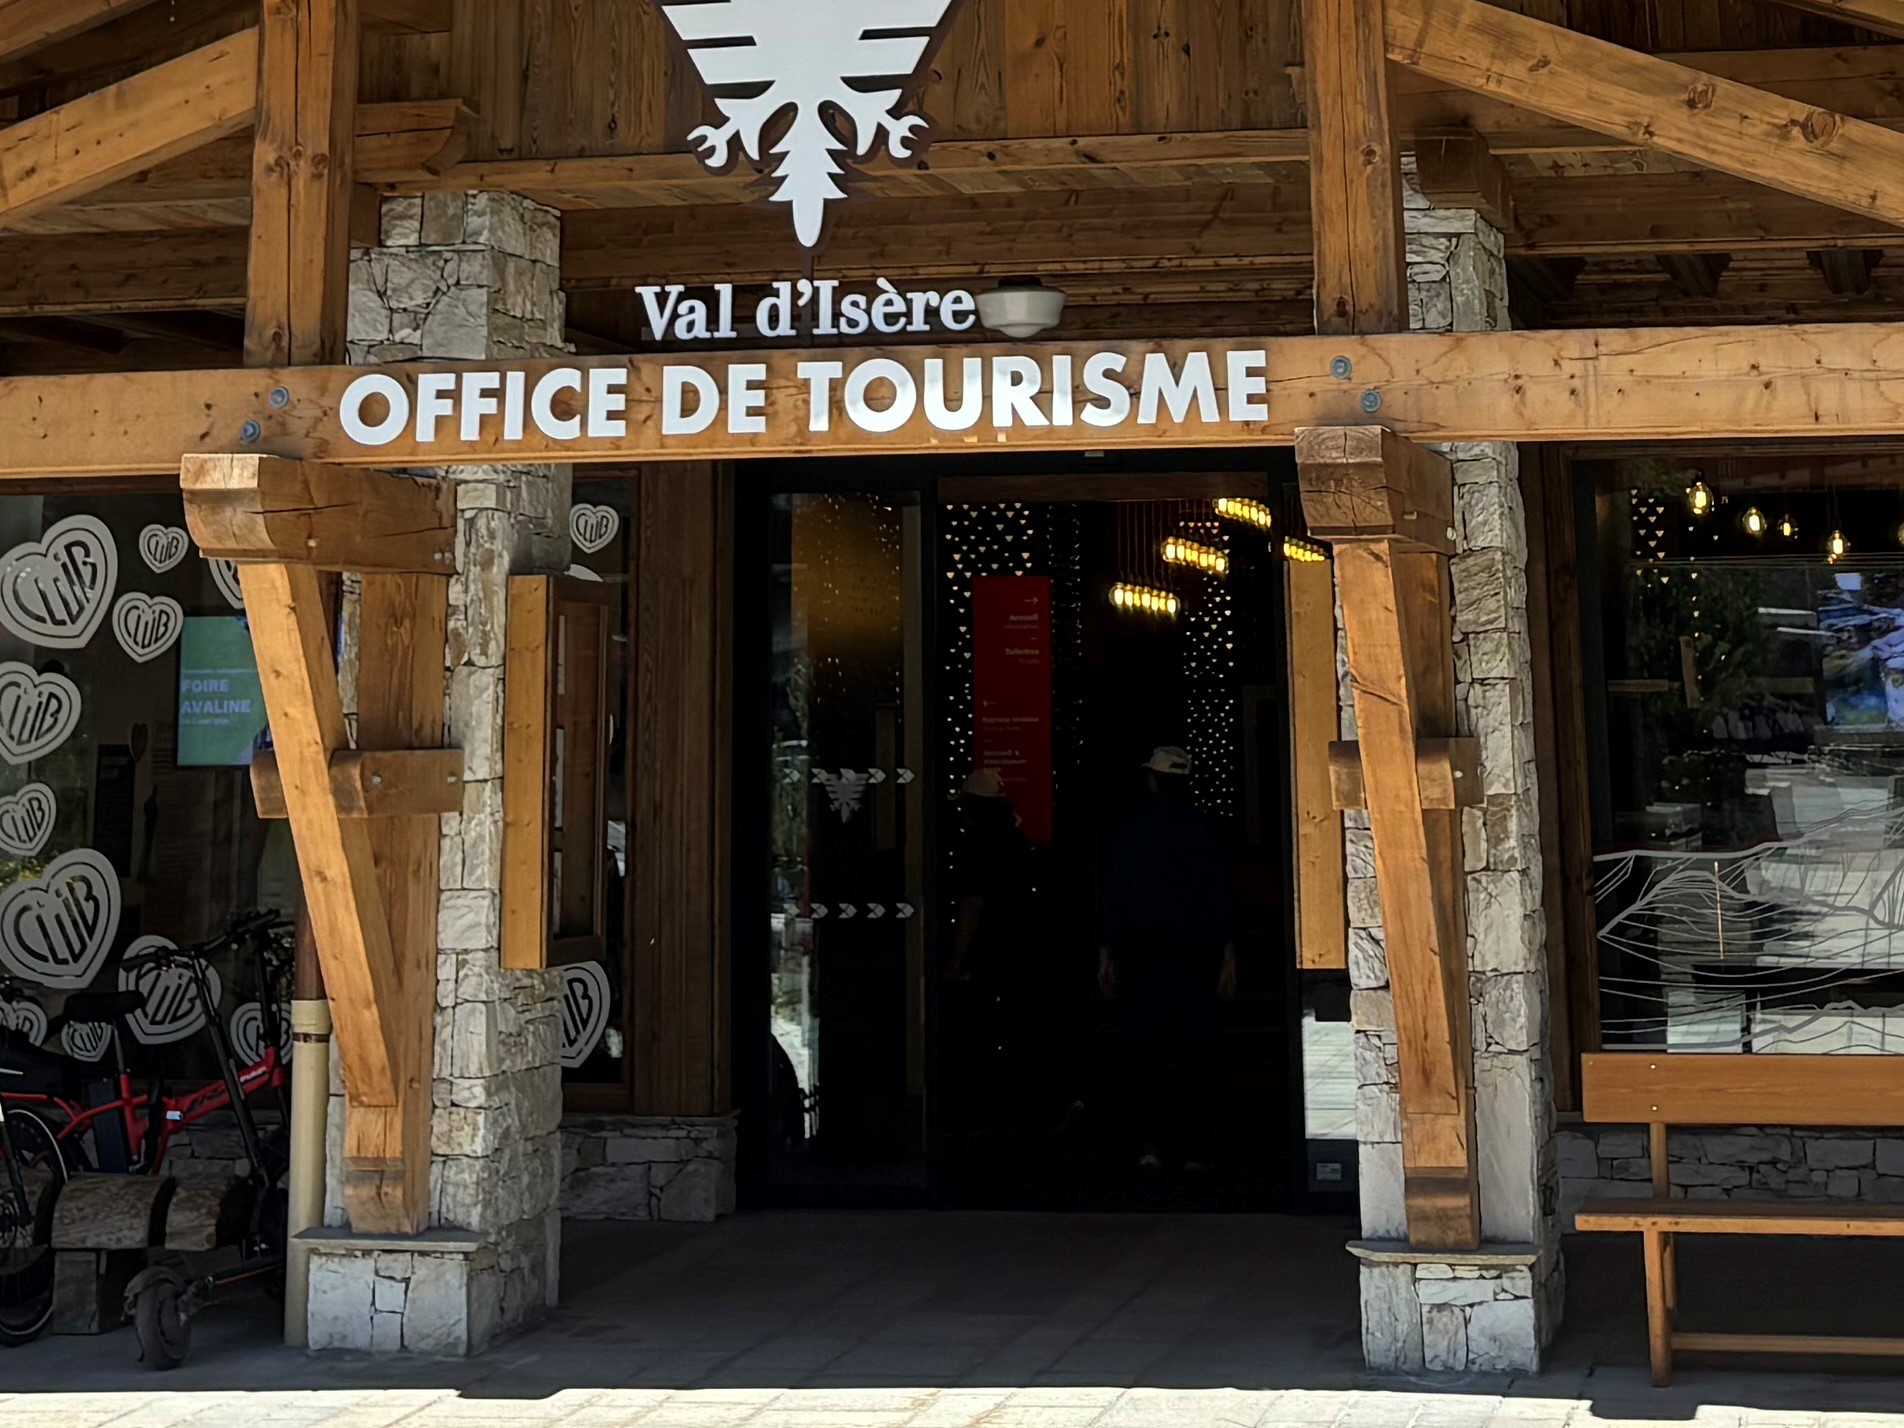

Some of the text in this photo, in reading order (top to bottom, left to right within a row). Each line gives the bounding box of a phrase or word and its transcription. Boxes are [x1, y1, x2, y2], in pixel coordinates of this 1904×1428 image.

[635, 276, 977, 341] Val d'Isère
[338, 348, 1270, 445] OFFICE DE TOURISME
